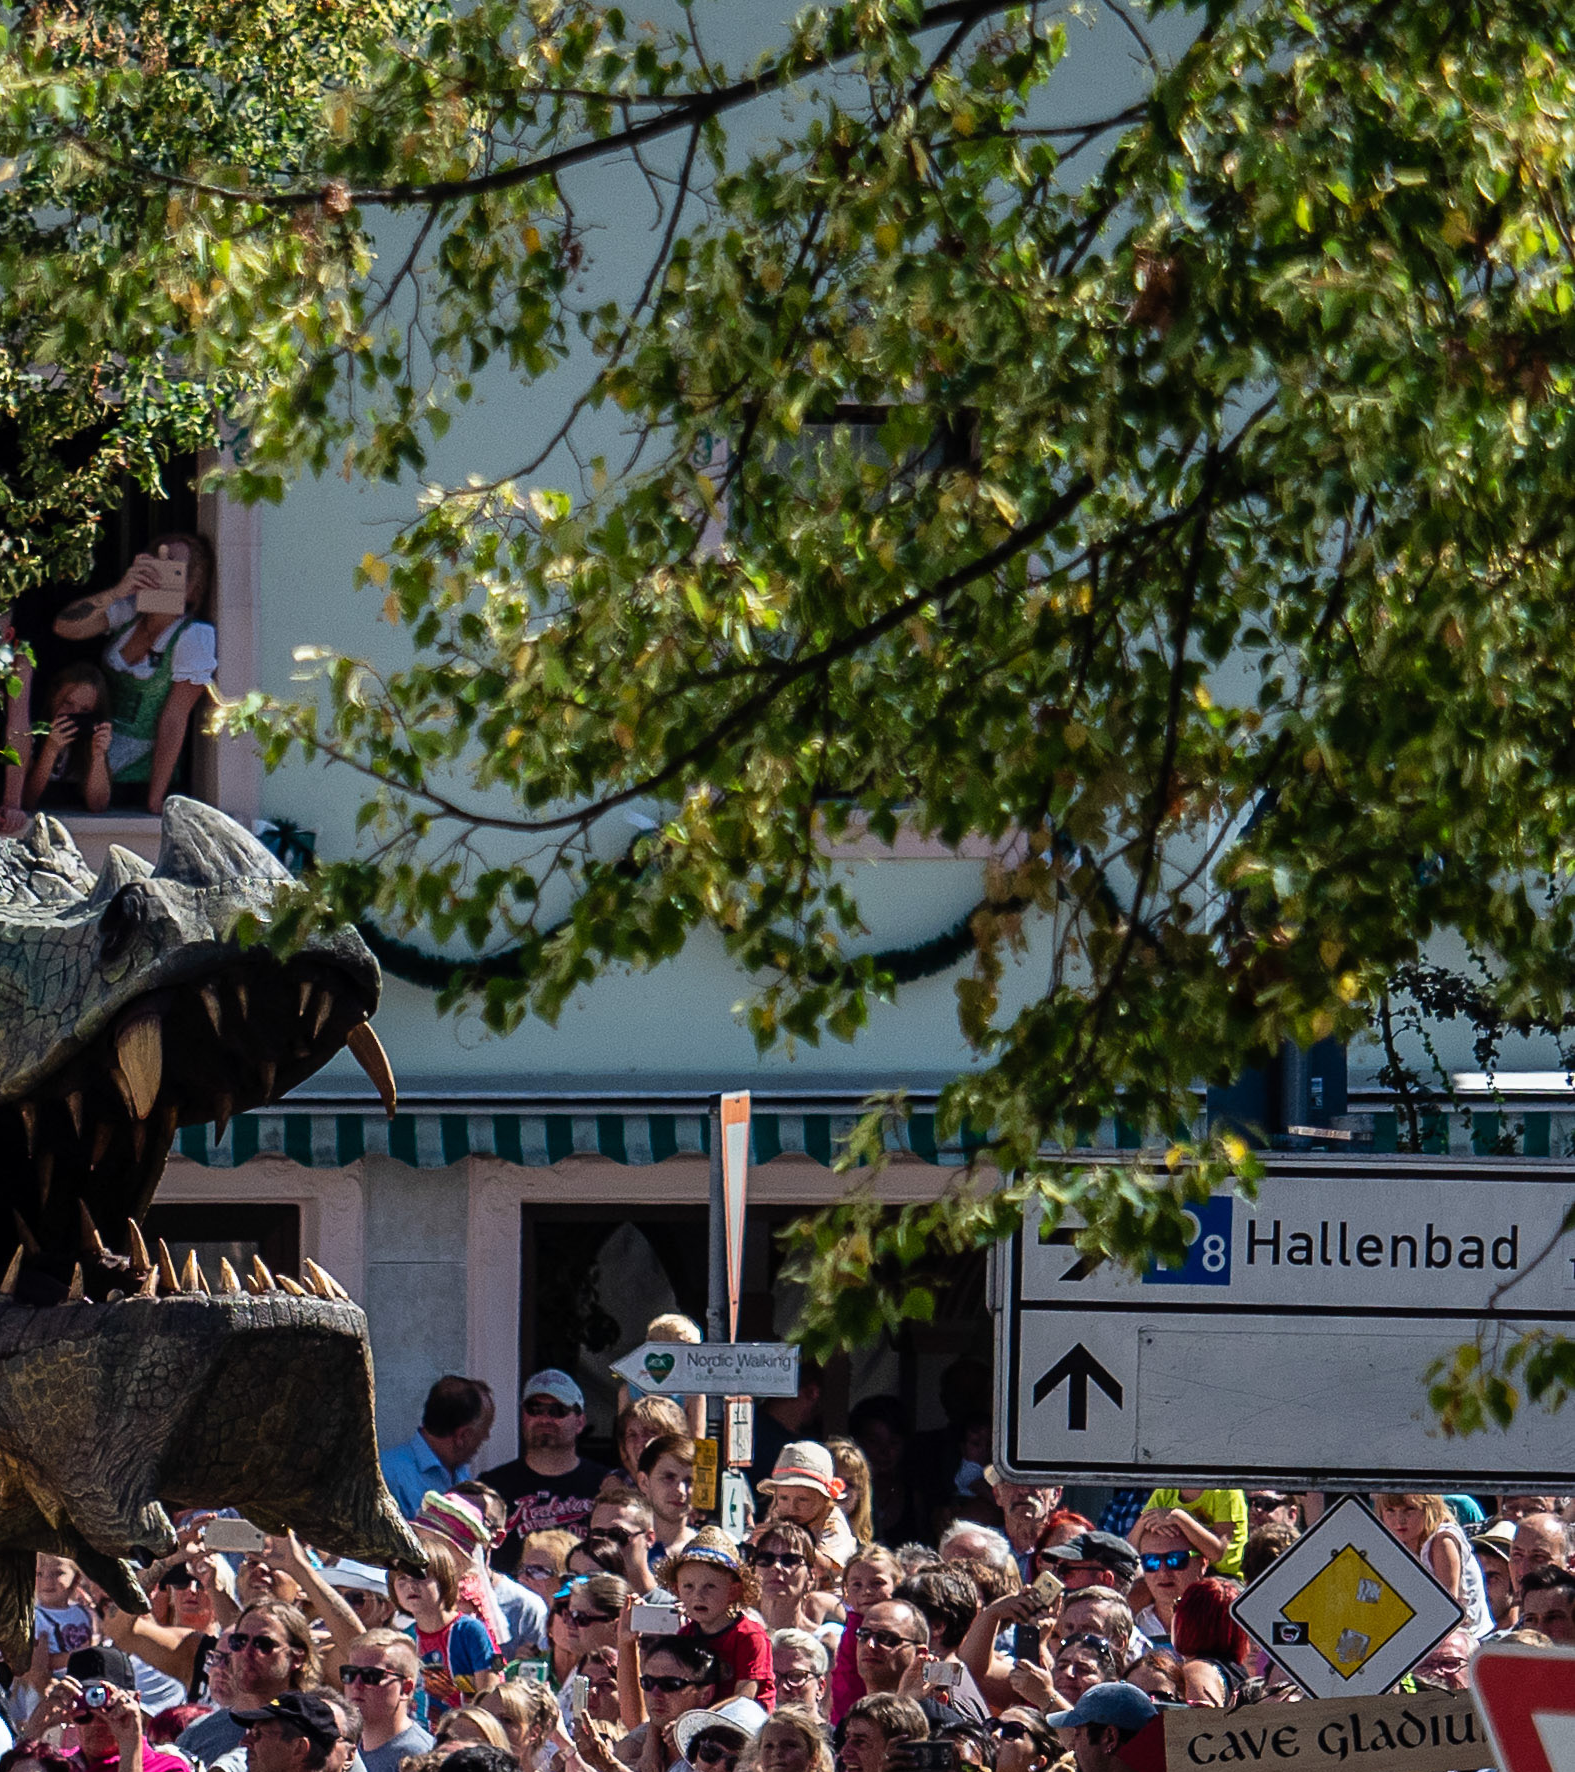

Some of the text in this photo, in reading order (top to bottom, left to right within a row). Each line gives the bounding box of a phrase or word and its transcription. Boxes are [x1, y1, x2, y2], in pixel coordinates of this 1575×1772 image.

[1246, 1218, 1520, 1271] Hallenbad
[686, 1351, 792, 1371] Nordic Walking
